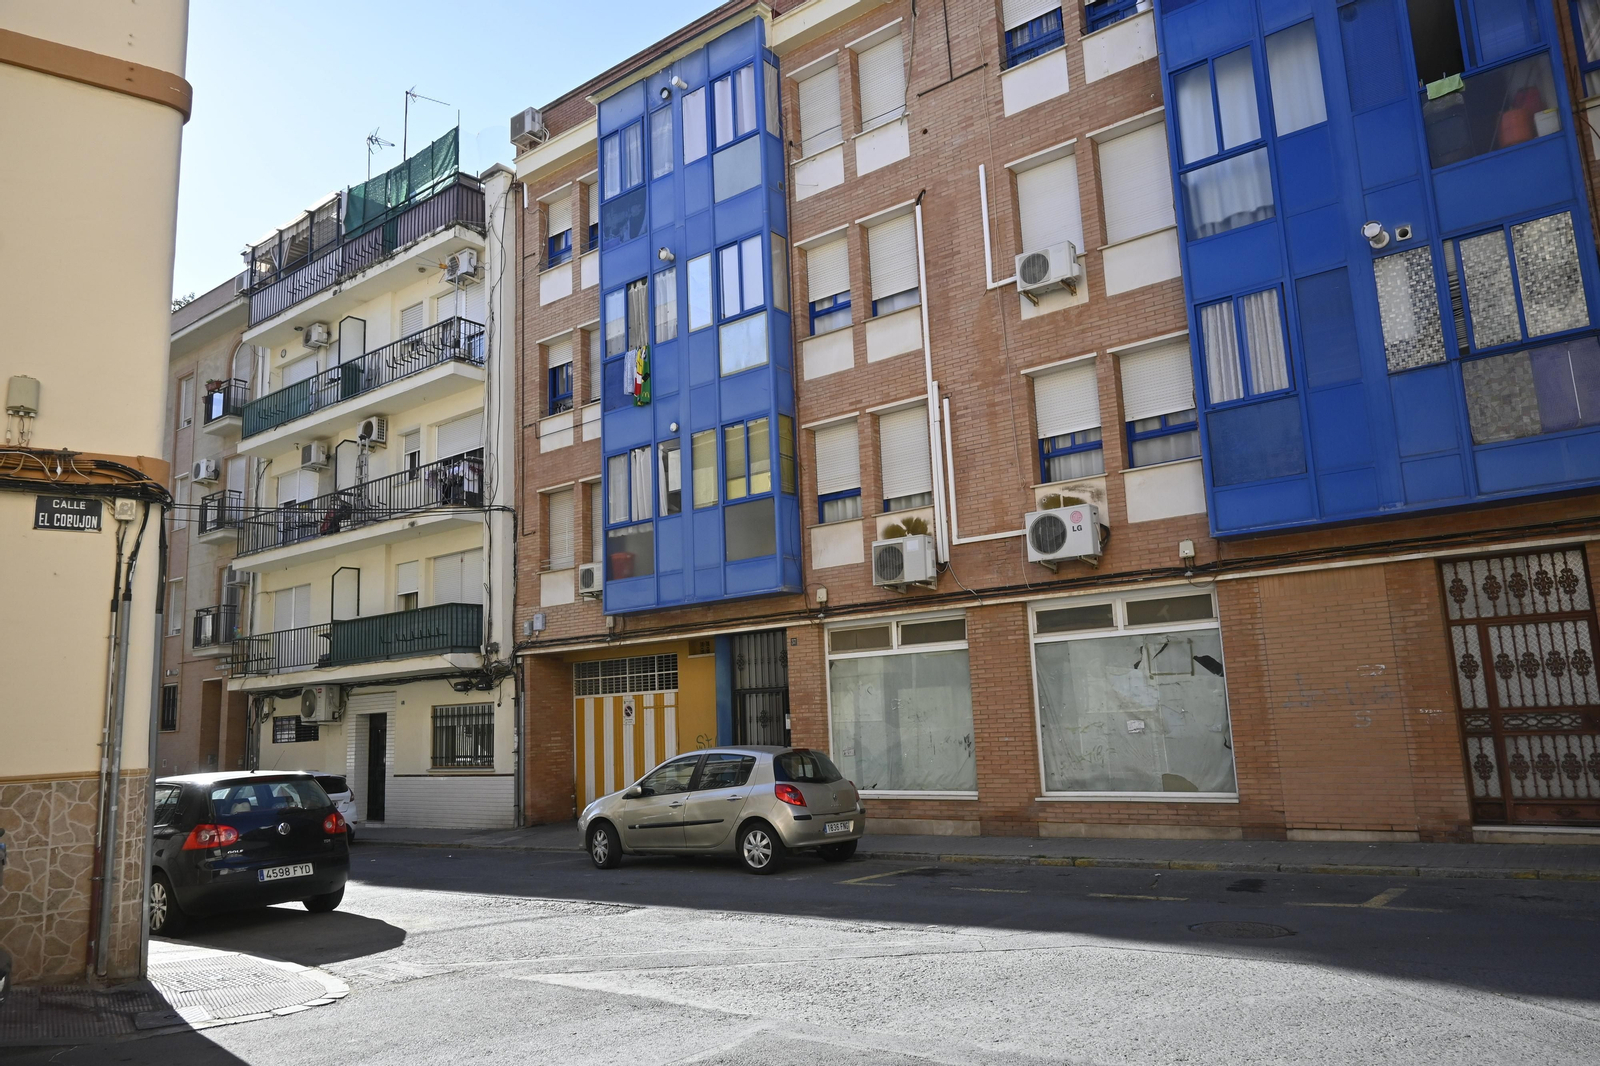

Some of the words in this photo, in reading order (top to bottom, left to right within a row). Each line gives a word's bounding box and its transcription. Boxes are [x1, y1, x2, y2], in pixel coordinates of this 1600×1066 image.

[52, 499, 86, 510] CALLE
[38, 512, 50, 526] EL
[1072, 524, 1083, 532] LG
[266, 867, 291, 878] 4598
[292, 865, 311, 875] FYD
